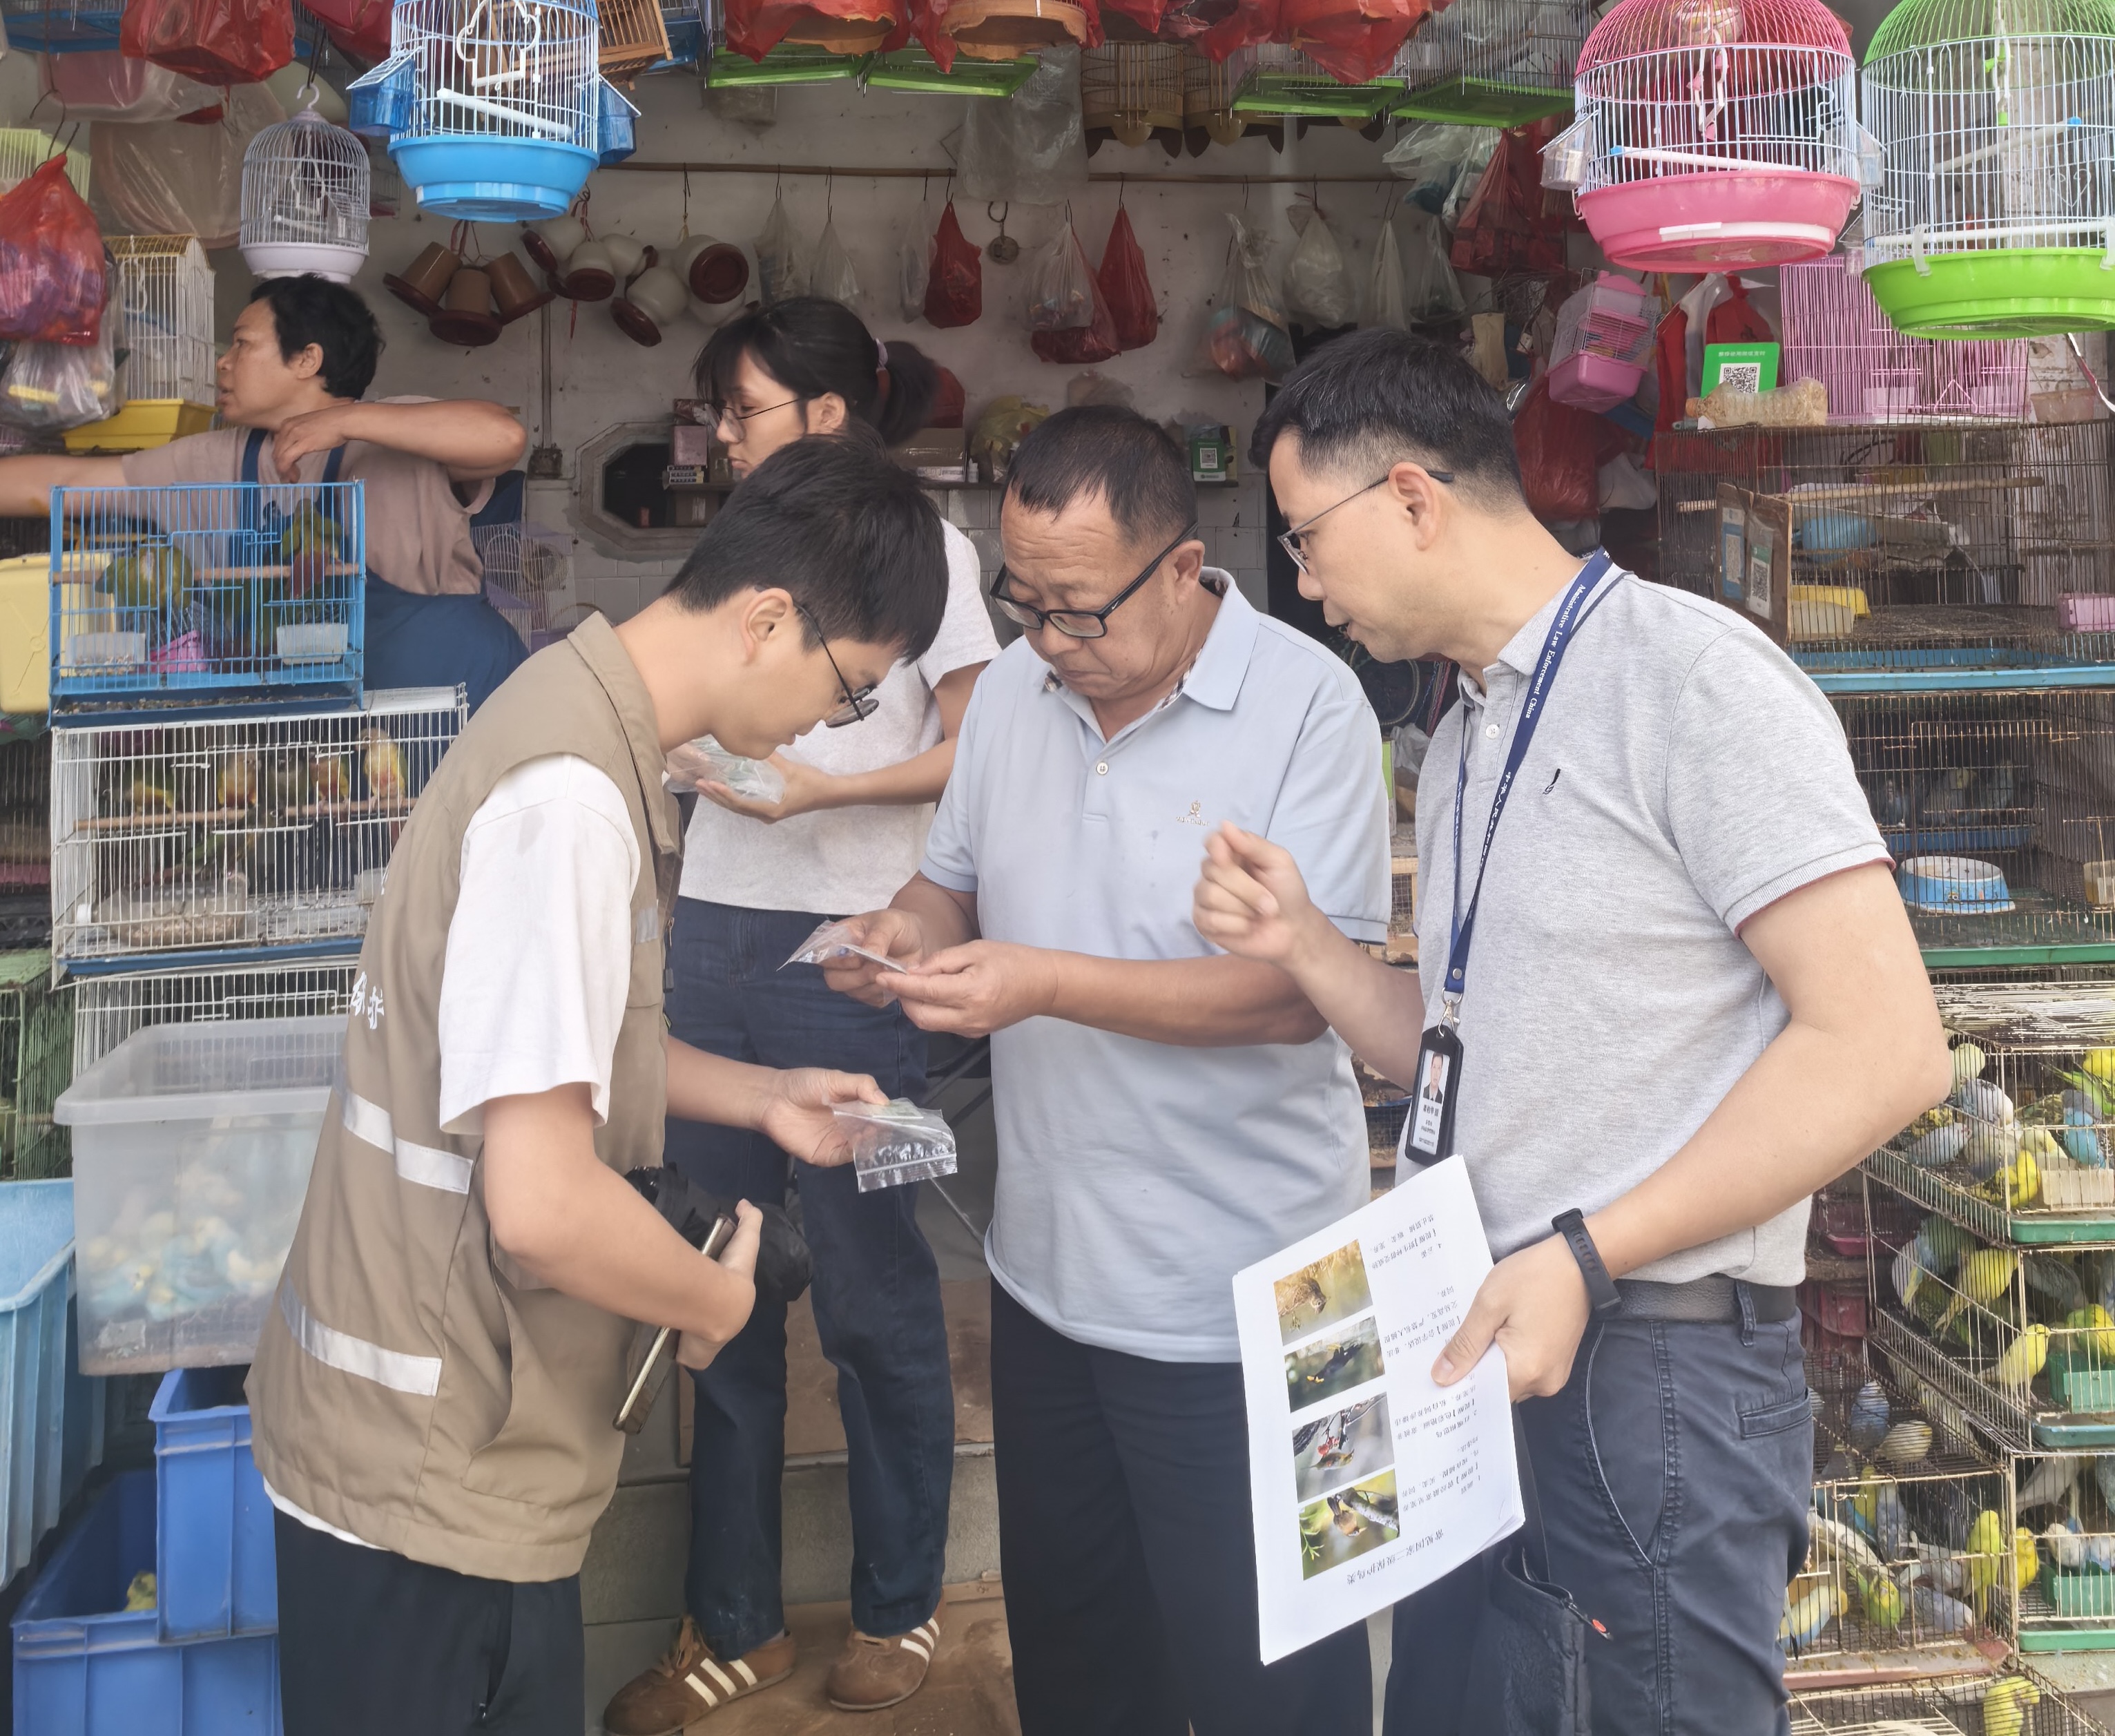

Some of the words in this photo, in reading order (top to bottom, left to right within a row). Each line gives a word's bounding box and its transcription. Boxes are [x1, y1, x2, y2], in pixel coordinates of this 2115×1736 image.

[1559, 584, 1586, 628] Administrative
[1551, 631, 1563, 648] Law
[1534, 650, 1556, 695] Enforcement
[1525, 698, 1538, 719] China
[1346, 1527, 1444, 1588] 常见国家二级保护鸟类
